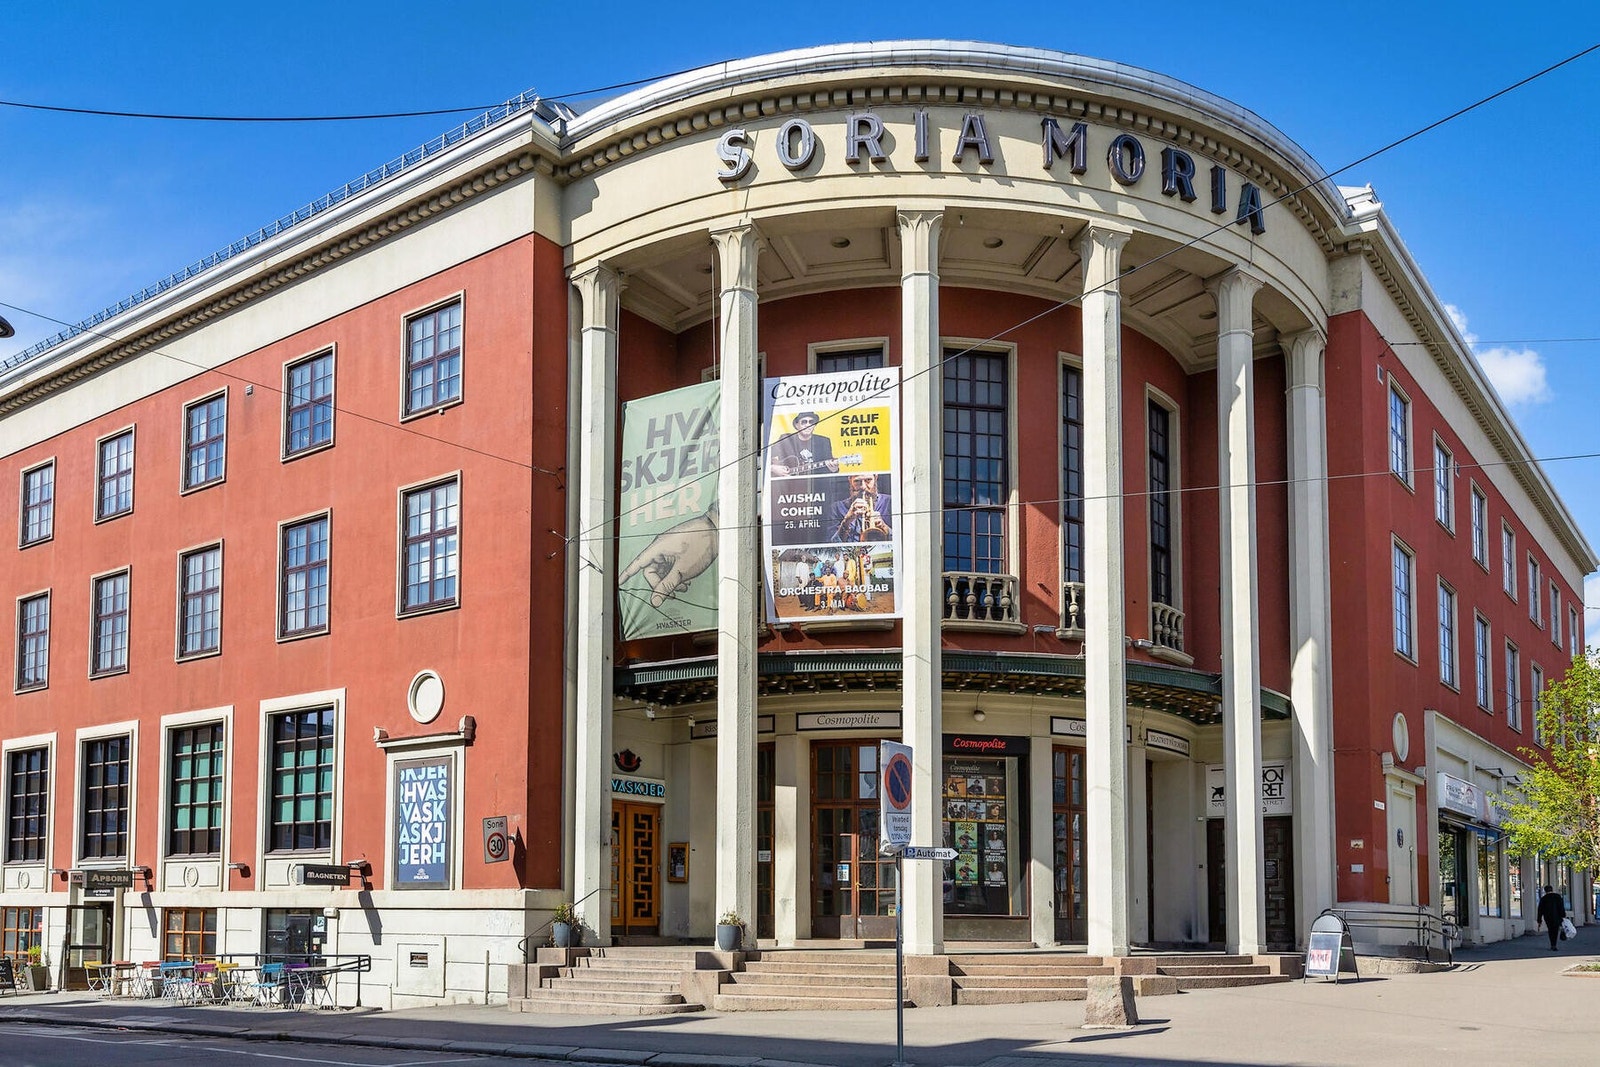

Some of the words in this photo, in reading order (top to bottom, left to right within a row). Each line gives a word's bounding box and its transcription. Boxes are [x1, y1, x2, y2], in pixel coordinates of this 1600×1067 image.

[715, 111, 995, 183] SORIA
[1040, 116, 1268, 236] MORIA
[771, 372, 890, 400] Cosmopolite
[800, 397, 829, 405] SCENE
[842, 394, 866, 402] OSLO
[841, 414, 879, 425] SALIF
[646, 407, 720, 449] HVA
[840, 425, 880, 437] KEITA
[855, 438, 877, 446] APRIL
[621, 441, 720, 494] SKJER
[629, 482, 702, 527] HER
[777, 493, 826, 504] AVISHAI
[781, 506, 823, 517] COHEN
[784, 521, 797, 529] 25.
[798, 519, 821, 528] APRIL
[779, 585, 841, 596] ORCHESTRA
[845, 583, 889, 593] BAOBAB
[816, 713, 881, 727] Cosmopolite
[953, 737, 1007, 752] Cosmopolite
[611, 778, 665, 797] VASKJER
[400, 801, 446, 822] VASK
[487, 820, 504, 829] Sone
[490, 839, 504, 852] 30
[399, 843, 445, 865] JERH
[916, 850, 951, 858] Automat
[307, 872, 347, 880] MAGNETEN
